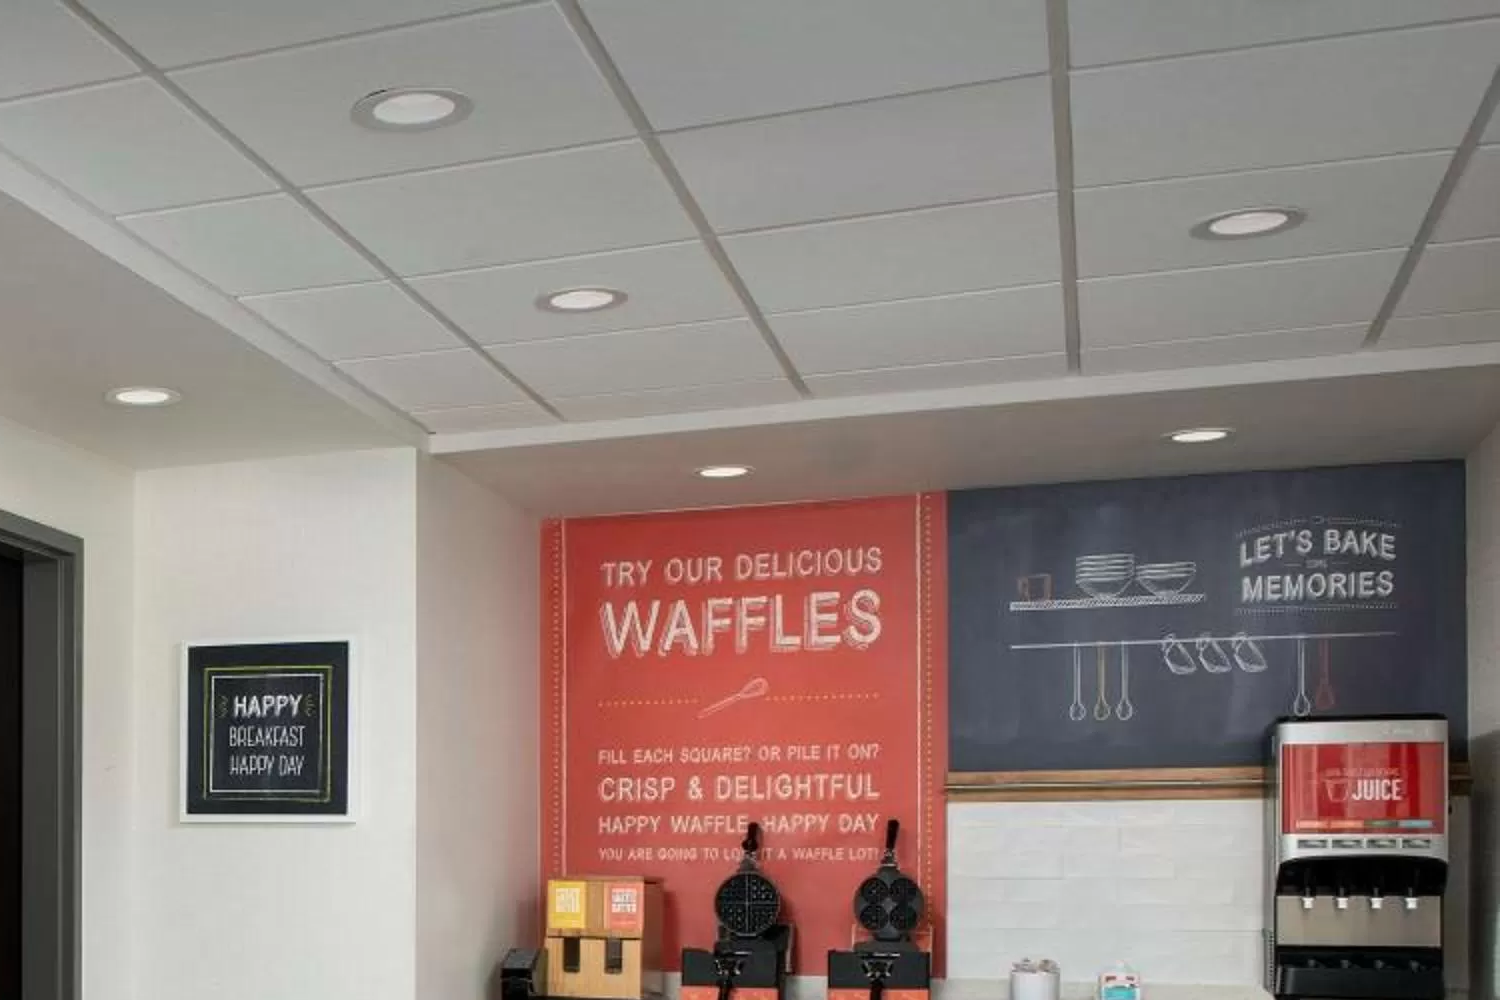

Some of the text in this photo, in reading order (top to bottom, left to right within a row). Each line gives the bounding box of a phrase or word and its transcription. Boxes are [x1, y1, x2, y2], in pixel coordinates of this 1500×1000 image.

[1240, 528, 1396, 568] LET'S BAKE
[602, 547, 882, 588] TRY OUR DELICIOUS
[1241, 570, 1395, 603] MEMORIES
[600, 588, 882, 658] WAFFLES
[233, 694, 302, 718] HAPPY
[229, 725, 306, 748] BREAKFAST
[230, 754, 304, 777] HAPPY DAY
[598, 743, 880, 765] FILL EACH SQUARE? OR PILE IT ON?
[598, 772, 881, 802] CRISP & DELIGHTFUL
[1351, 779, 1403, 801] JUICE
[598, 812, 880, 834] HAPPY WAFFLE HAPPY DAY
[598, 848, 623, 861] YOU
[627, 847, 653, 861] ARE
[657, 847, 698, 861] GOING
[704, 847, 719, 861] TO
[723, 848, 757, 862] LO
[777, 848, 788, 861] A
[793, 847, 845, 861] WAFFLE
